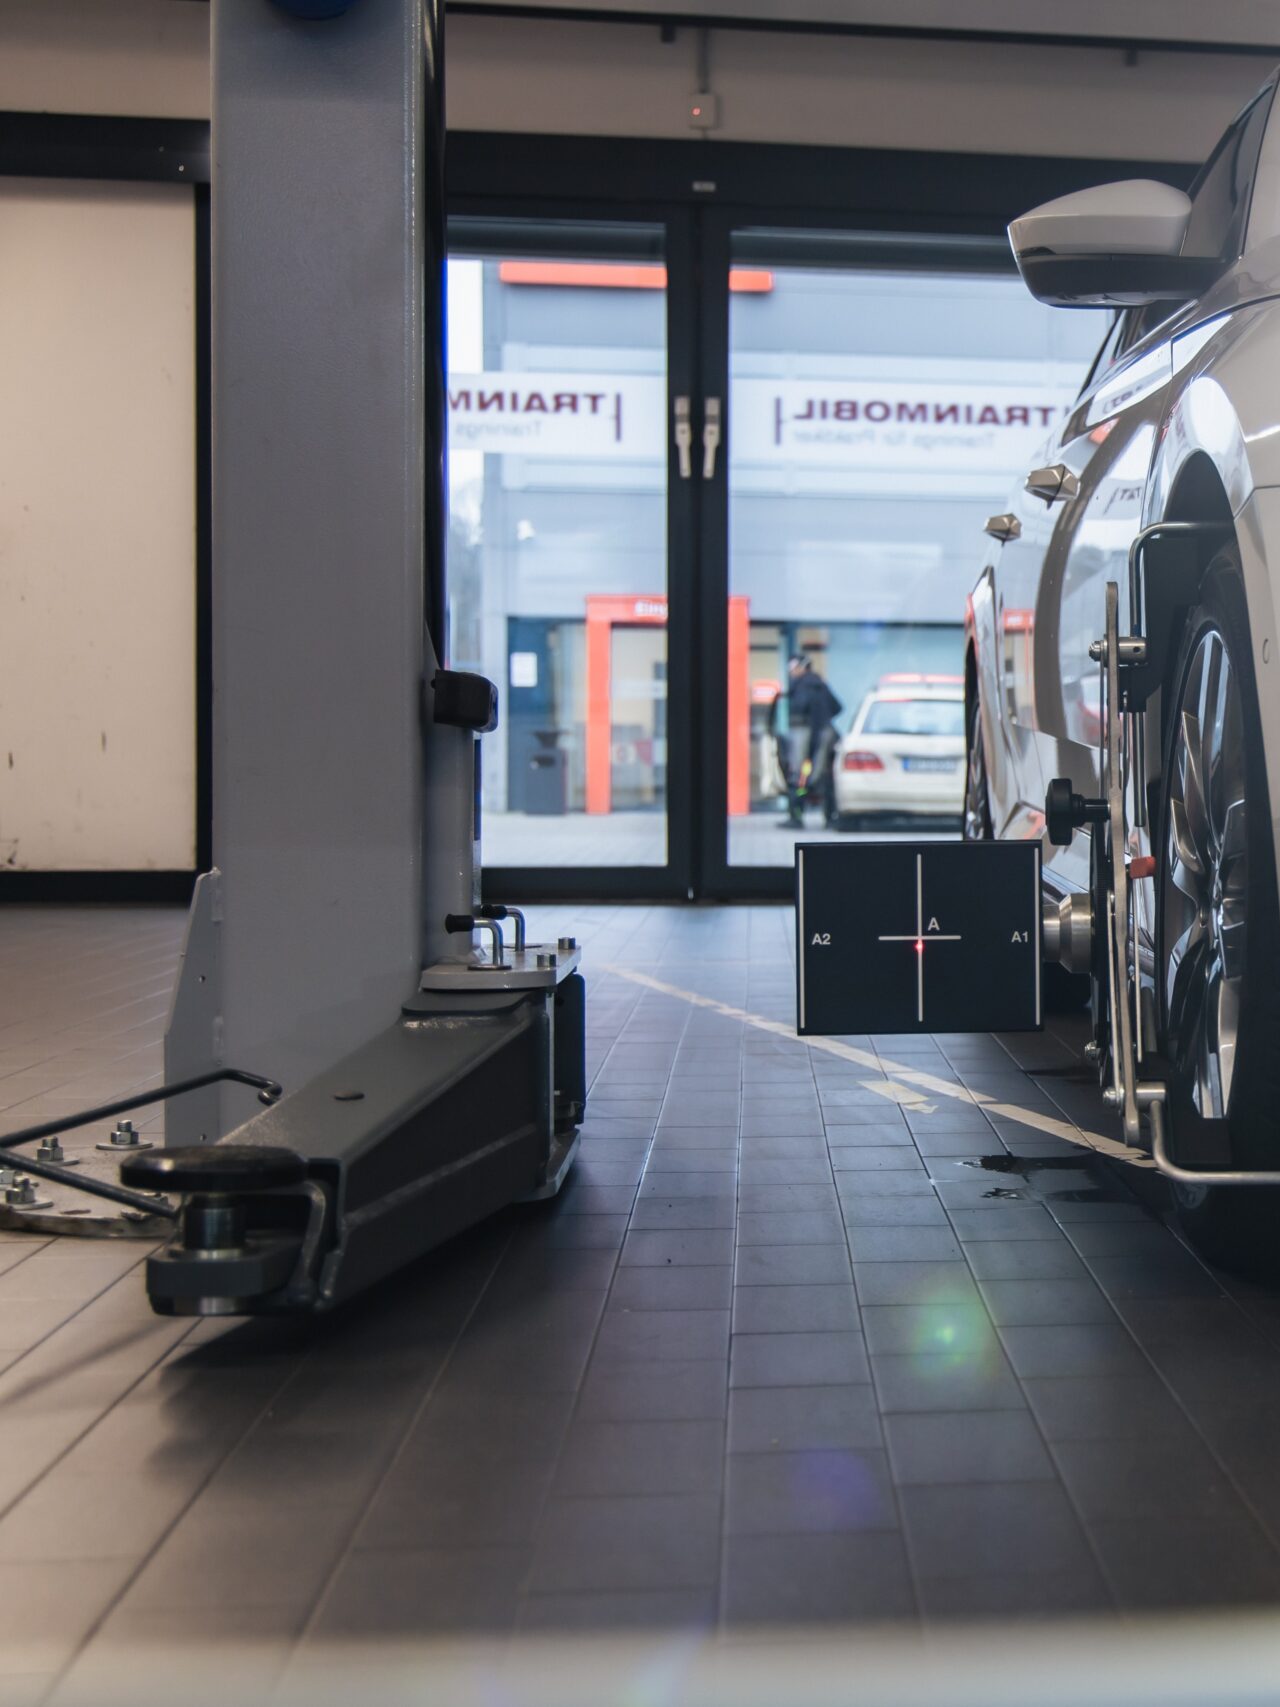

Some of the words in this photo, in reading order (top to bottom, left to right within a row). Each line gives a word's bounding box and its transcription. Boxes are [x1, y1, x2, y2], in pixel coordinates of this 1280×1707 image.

[928, 917, 940, 931] A
[812, 933, 831, 945] A2
[1011, 931, 1029, 943] A1
